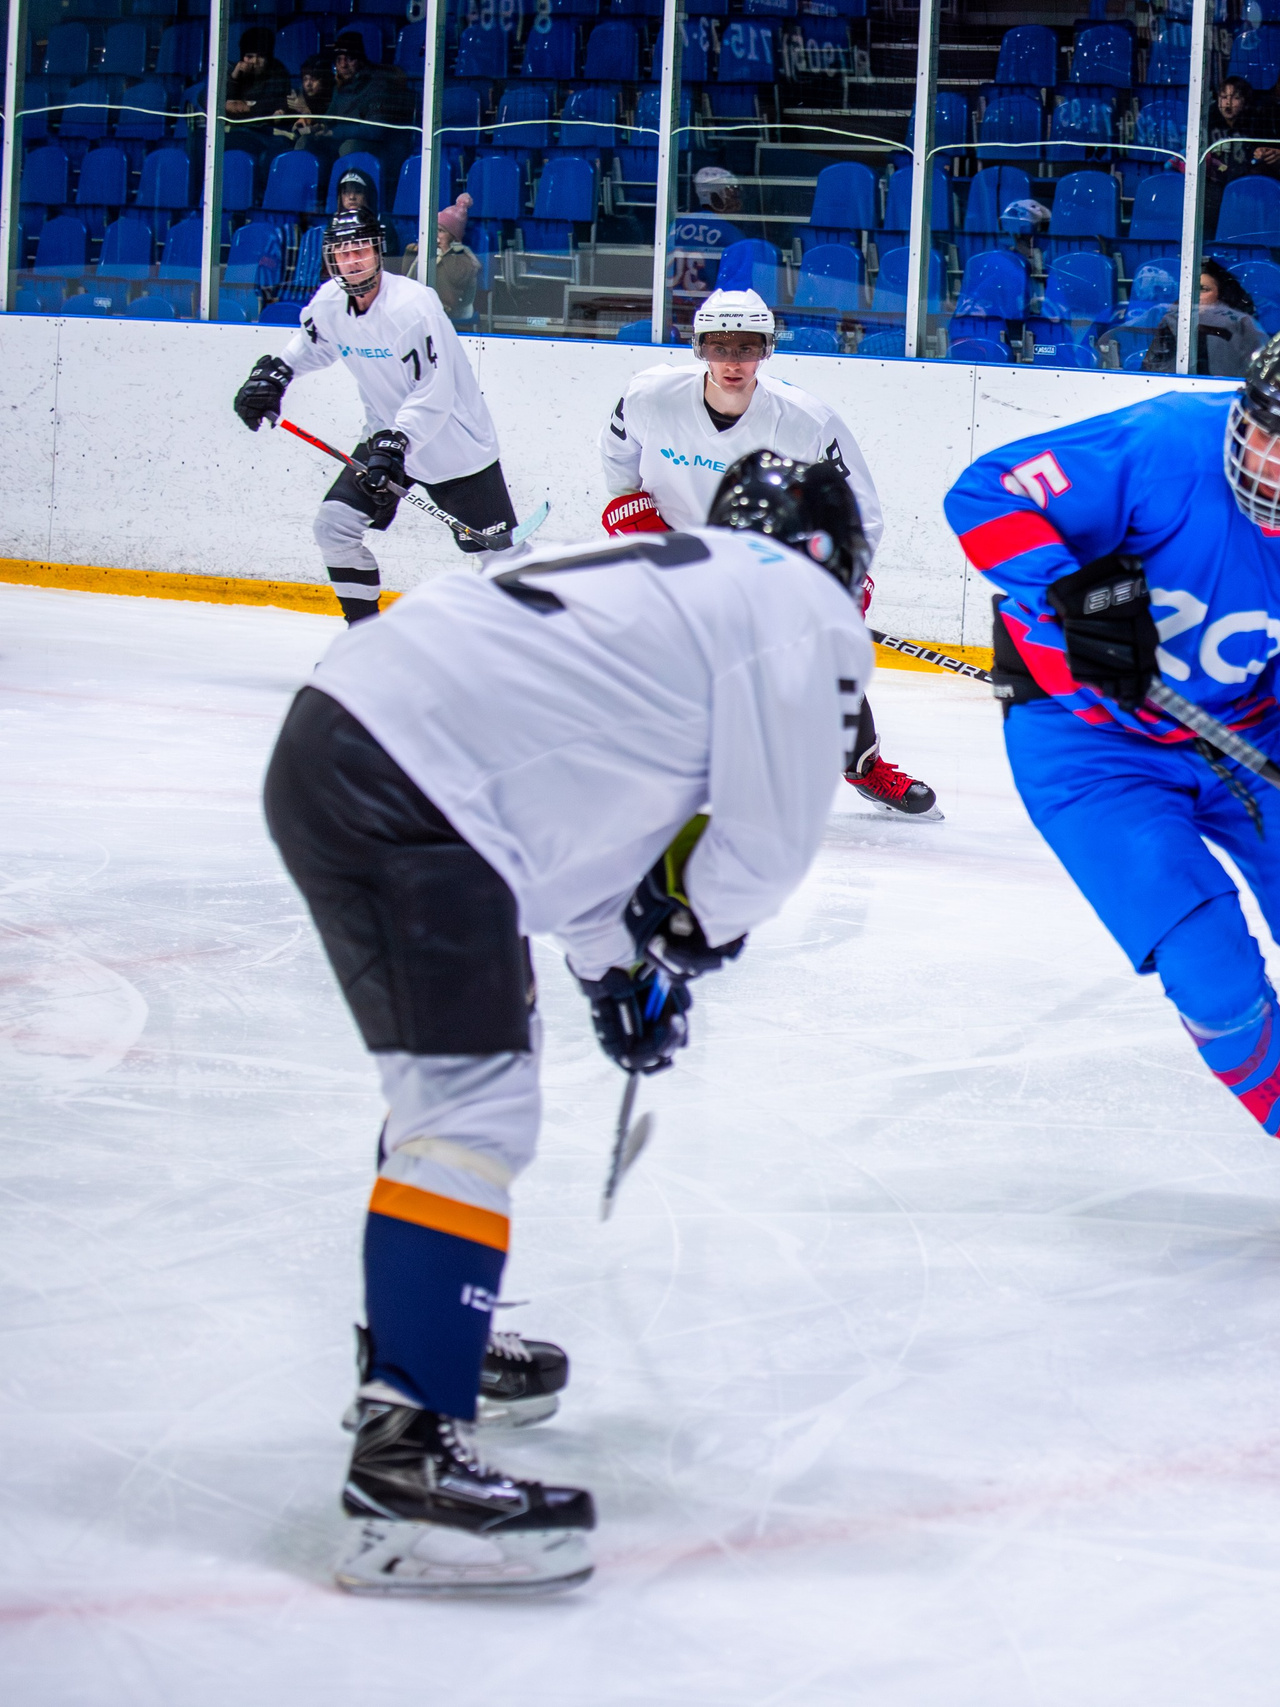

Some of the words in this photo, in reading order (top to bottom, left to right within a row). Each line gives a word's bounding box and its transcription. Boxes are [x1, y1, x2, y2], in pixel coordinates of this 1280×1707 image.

[405, 492, 458, 526] BAUER
[607, 497, 655, 527] WARRI
[459, 521, 507, 541] BER
[880, 634, 982, 678] BAUER
